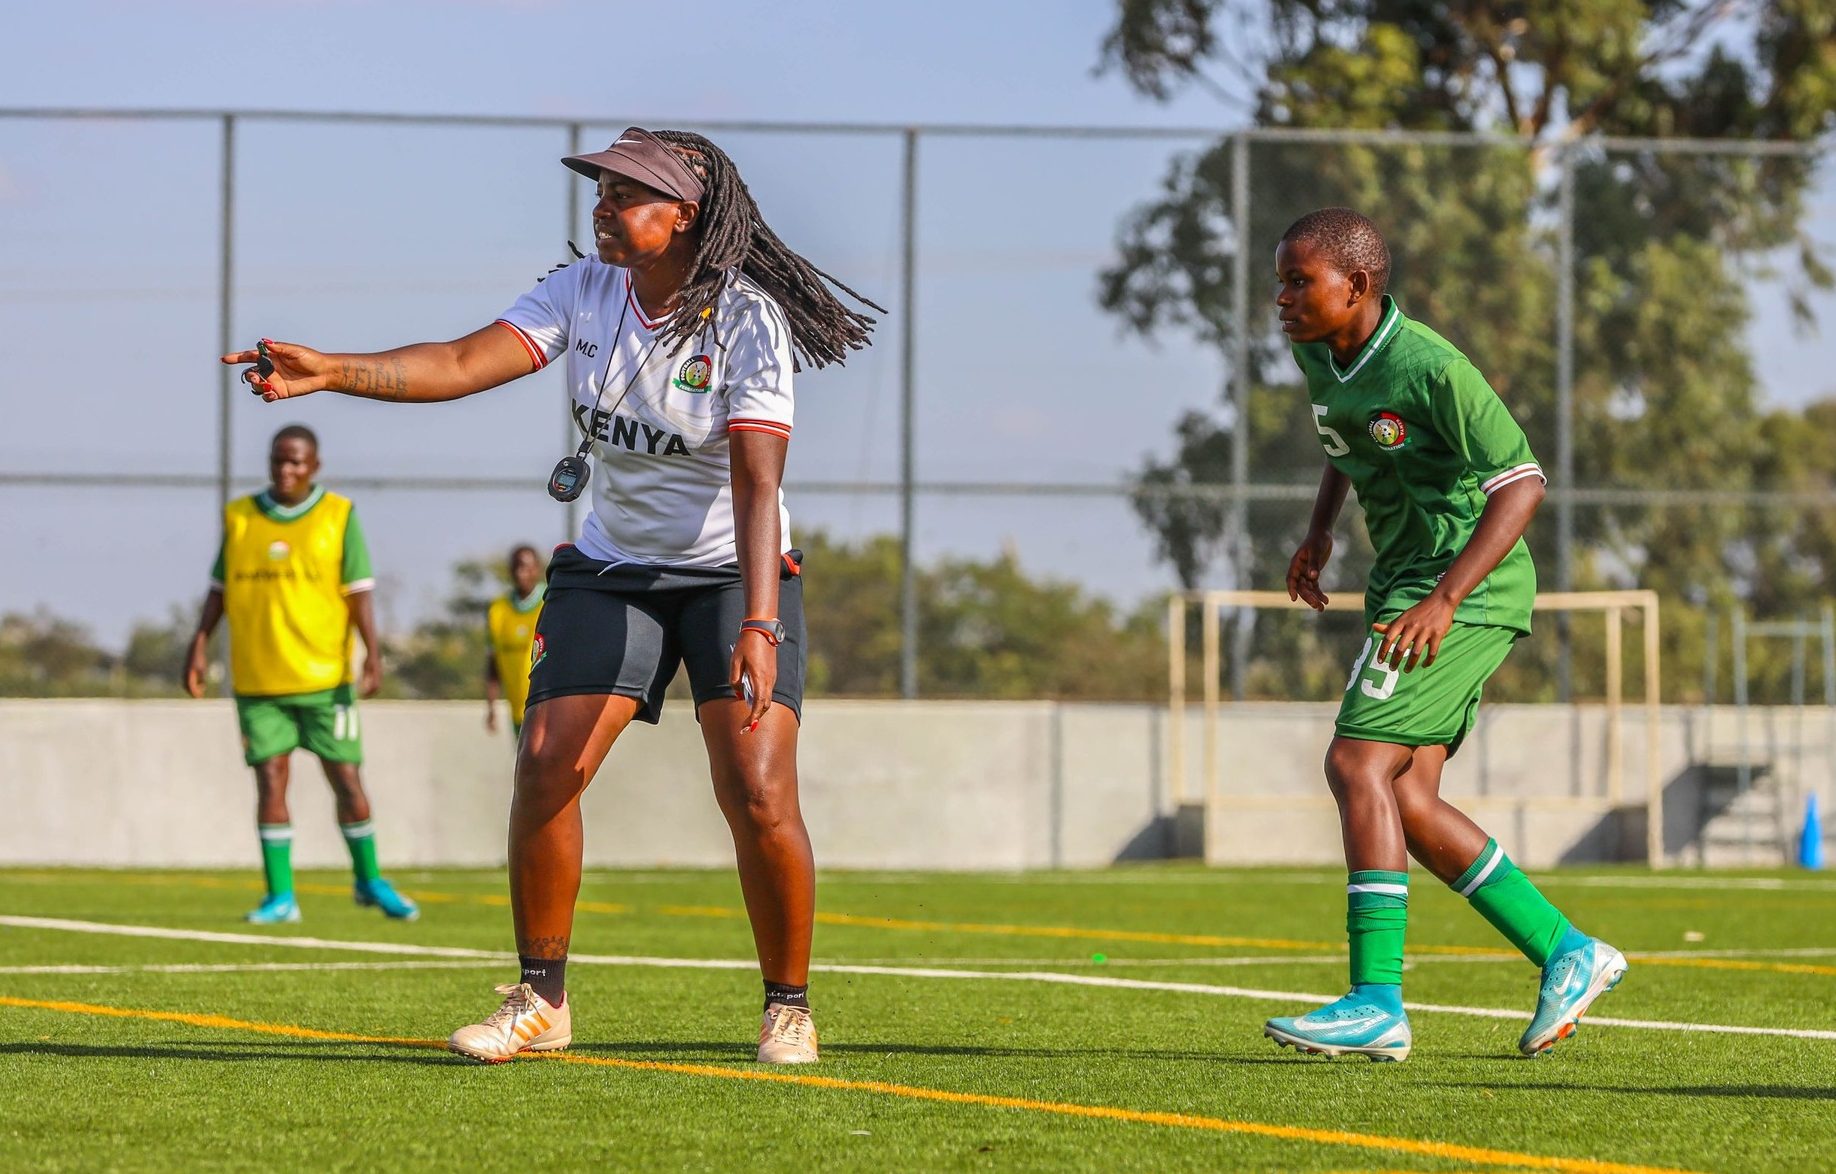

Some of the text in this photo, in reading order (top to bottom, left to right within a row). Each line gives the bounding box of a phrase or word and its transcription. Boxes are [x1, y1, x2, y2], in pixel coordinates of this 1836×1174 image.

[575, 338, 598, 358] M.C
[571, 398, 691, 456] KENYA
[522, 968, 547, 977] port
